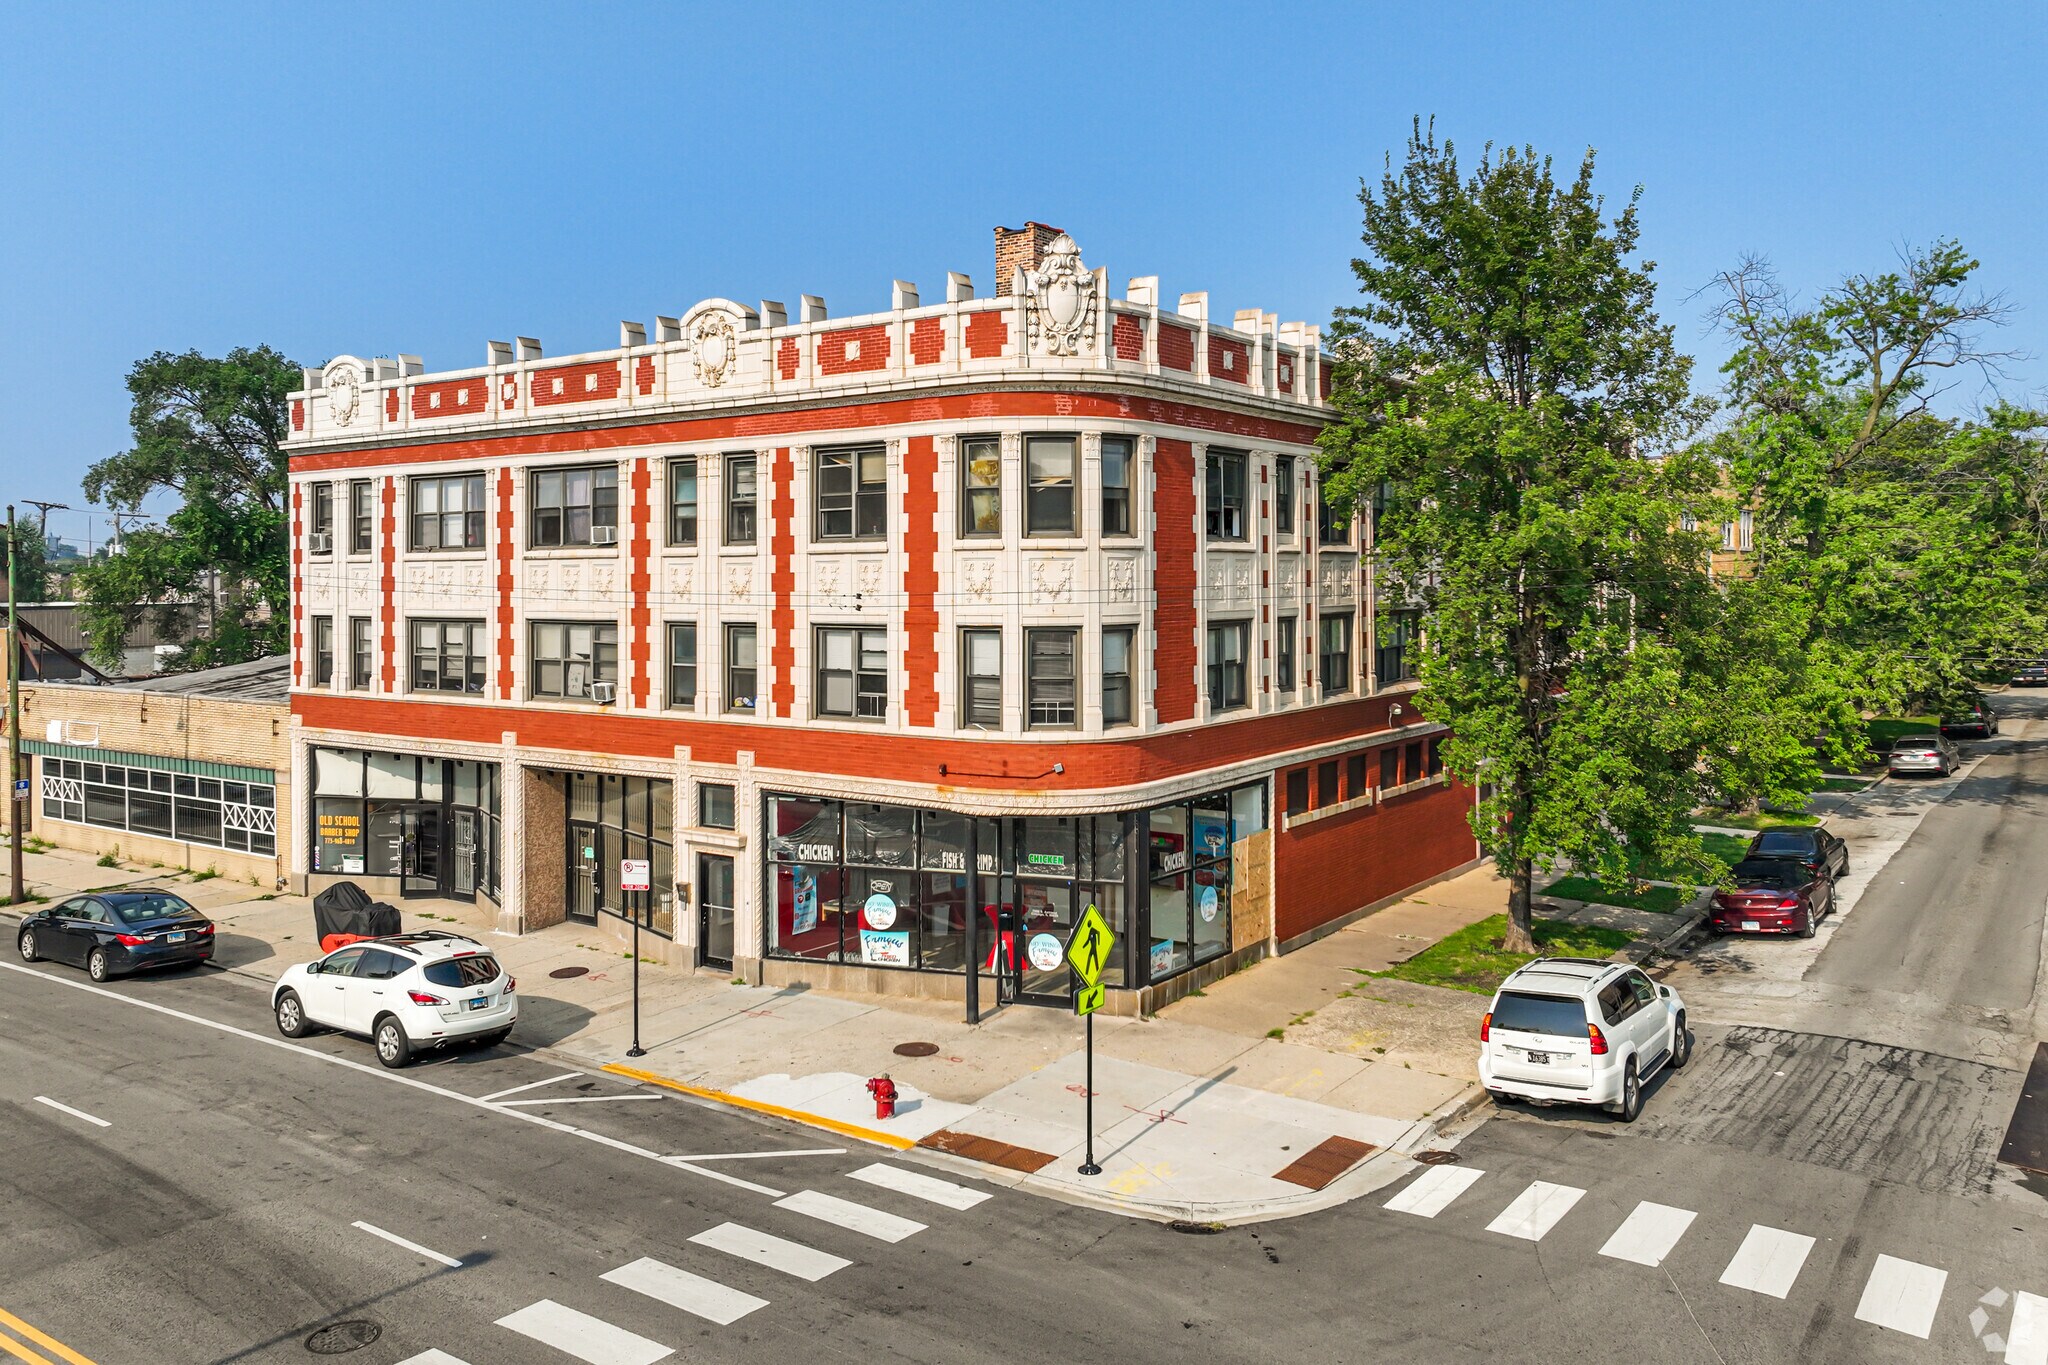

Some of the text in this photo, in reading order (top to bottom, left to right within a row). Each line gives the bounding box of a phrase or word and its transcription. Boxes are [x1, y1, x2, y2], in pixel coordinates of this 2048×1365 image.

[319, 815, 360, 827] OLD SCHOOL
[344, 828, 360, 837] SHOP
[798, 843, 834, 861] CHICKEN
[1027, 853, 1065, 866] CHICKEN
[942, 851, 958, 869] FISH
[1163, 851, 1186, 873] CHICKEN
